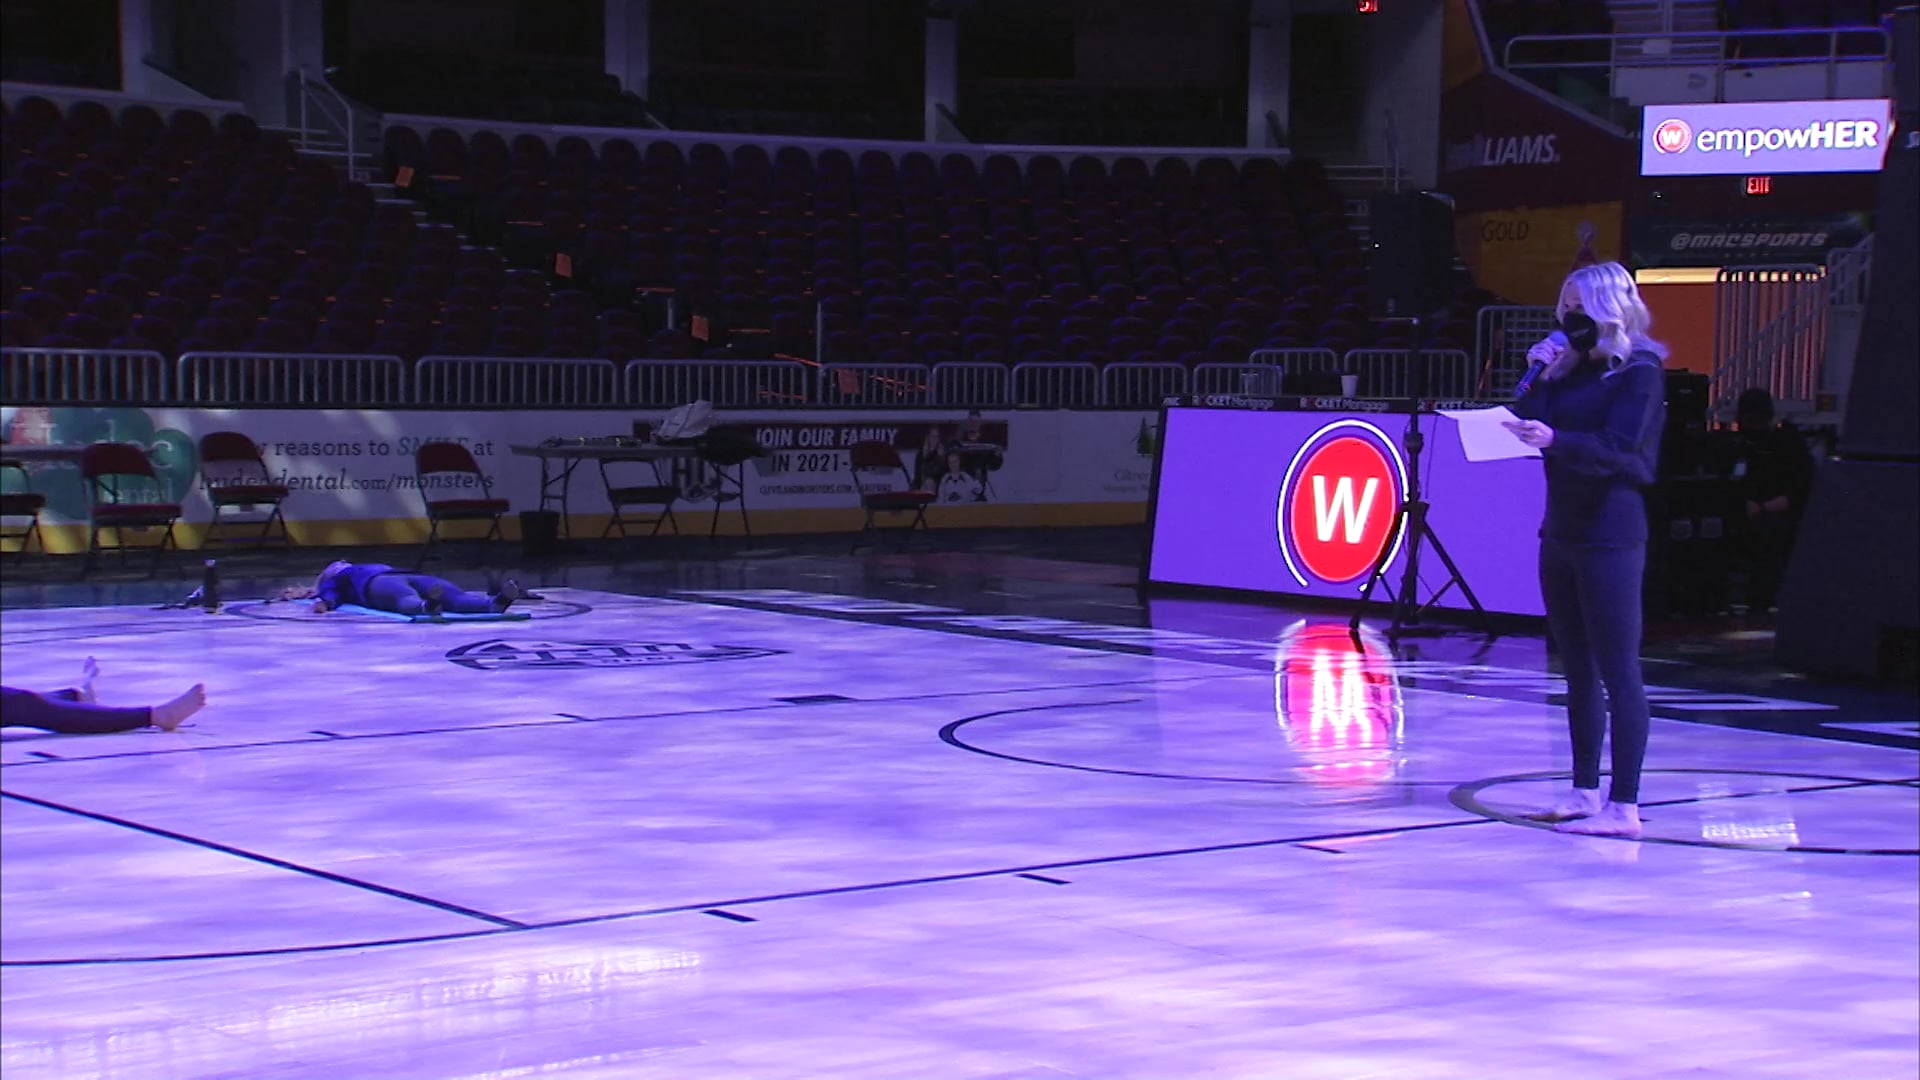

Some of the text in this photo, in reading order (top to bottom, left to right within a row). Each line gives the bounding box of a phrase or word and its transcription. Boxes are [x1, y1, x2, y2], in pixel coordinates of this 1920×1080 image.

[1662, 129, 1682, 145] W
[1696, 121, 1879, 158] empowHER
[1481, 220, 1529, 242] GOLD
[1670, 232, 1829, 250] @MACSPORTS
[797, 427, 835, 447] OUR
[274, 440, 362, 457] reasons
[369, 438, 390, 457] to
[473, 440, 495, 457] at
[772, 454, 790, 472] IN
[1312, 475, 1380, 544] W
